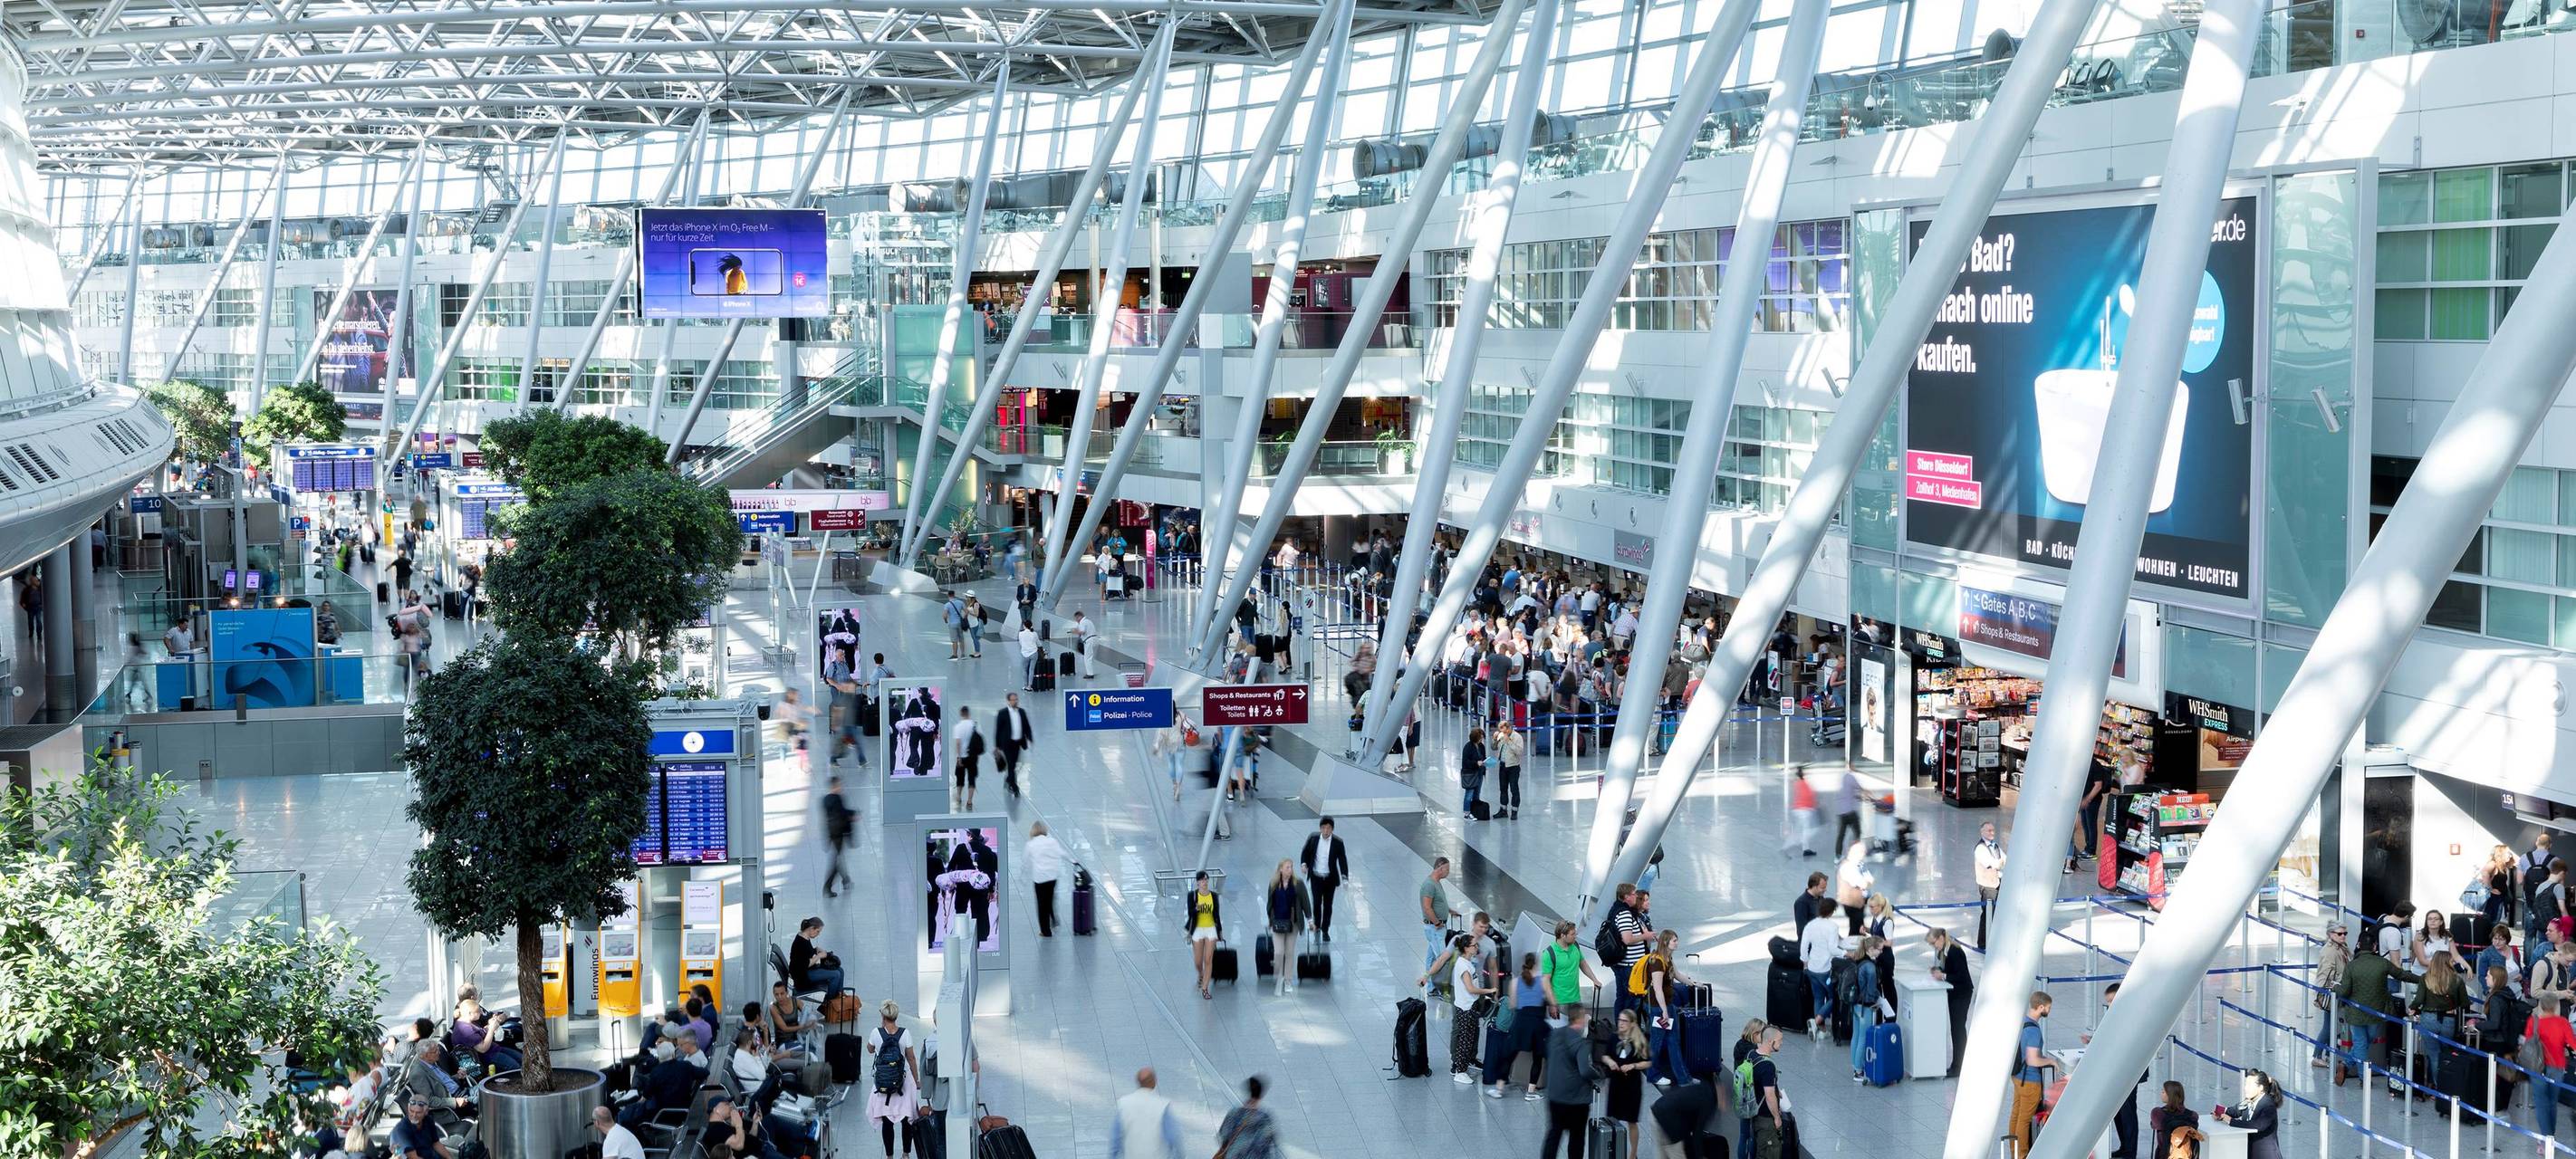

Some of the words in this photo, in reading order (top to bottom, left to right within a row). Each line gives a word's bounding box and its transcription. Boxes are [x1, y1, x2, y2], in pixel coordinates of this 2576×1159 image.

[650, 223, 668, 233] Jetzt
[669, 223, 684, 232] das
[684, 223, 711, 232] iPhone
[712, 224, 718, 232] X
[719, 224, 729, 232] im
[742, 223, 758, 232] Free
[759, 223, 768, 232] M
[650, 234, 664, 242] nur
[666, 233, 677, 242] für
[678, 233, 698, 242] kurze
[700, 233, 716, 242] Zeit.
[1972, 233, 2015, 272] Bad?
[1981, 285, 2033, 324] online
[1918, 335, 1976, 373] kaufen.
[1917, 457, 1934, 472] Store
[1935, 459, 1968, 475] Düsseldorf
[149, 499, 161, 509] 10
[293, 519, 300, 528] P
[1617, 542, 1644, 563] Eurowings
[2026, 539, 2043, 556] BAD
[2137, 557, 2177, 578] WOHNEN
[2187, 564, 2238, 588] LEUCHTEN
[1981, 593, 2007, 614] Gates
[1916, 632, 1944, 651] WHSmith
[1980, 623, 1998, 639] Shops
[1998, 627, 2004, 638] &
[2004, 628, 2039, 647] Restaurants
[1104, 694, 1144, 704] Information
[1209, 692, 1228, 700] Shops
[1104, 711, 1127, 719] Polizei
[2188, 698, 2228, 723] WHSmith
[2205, 718, 2228, 732] EXPRESS
